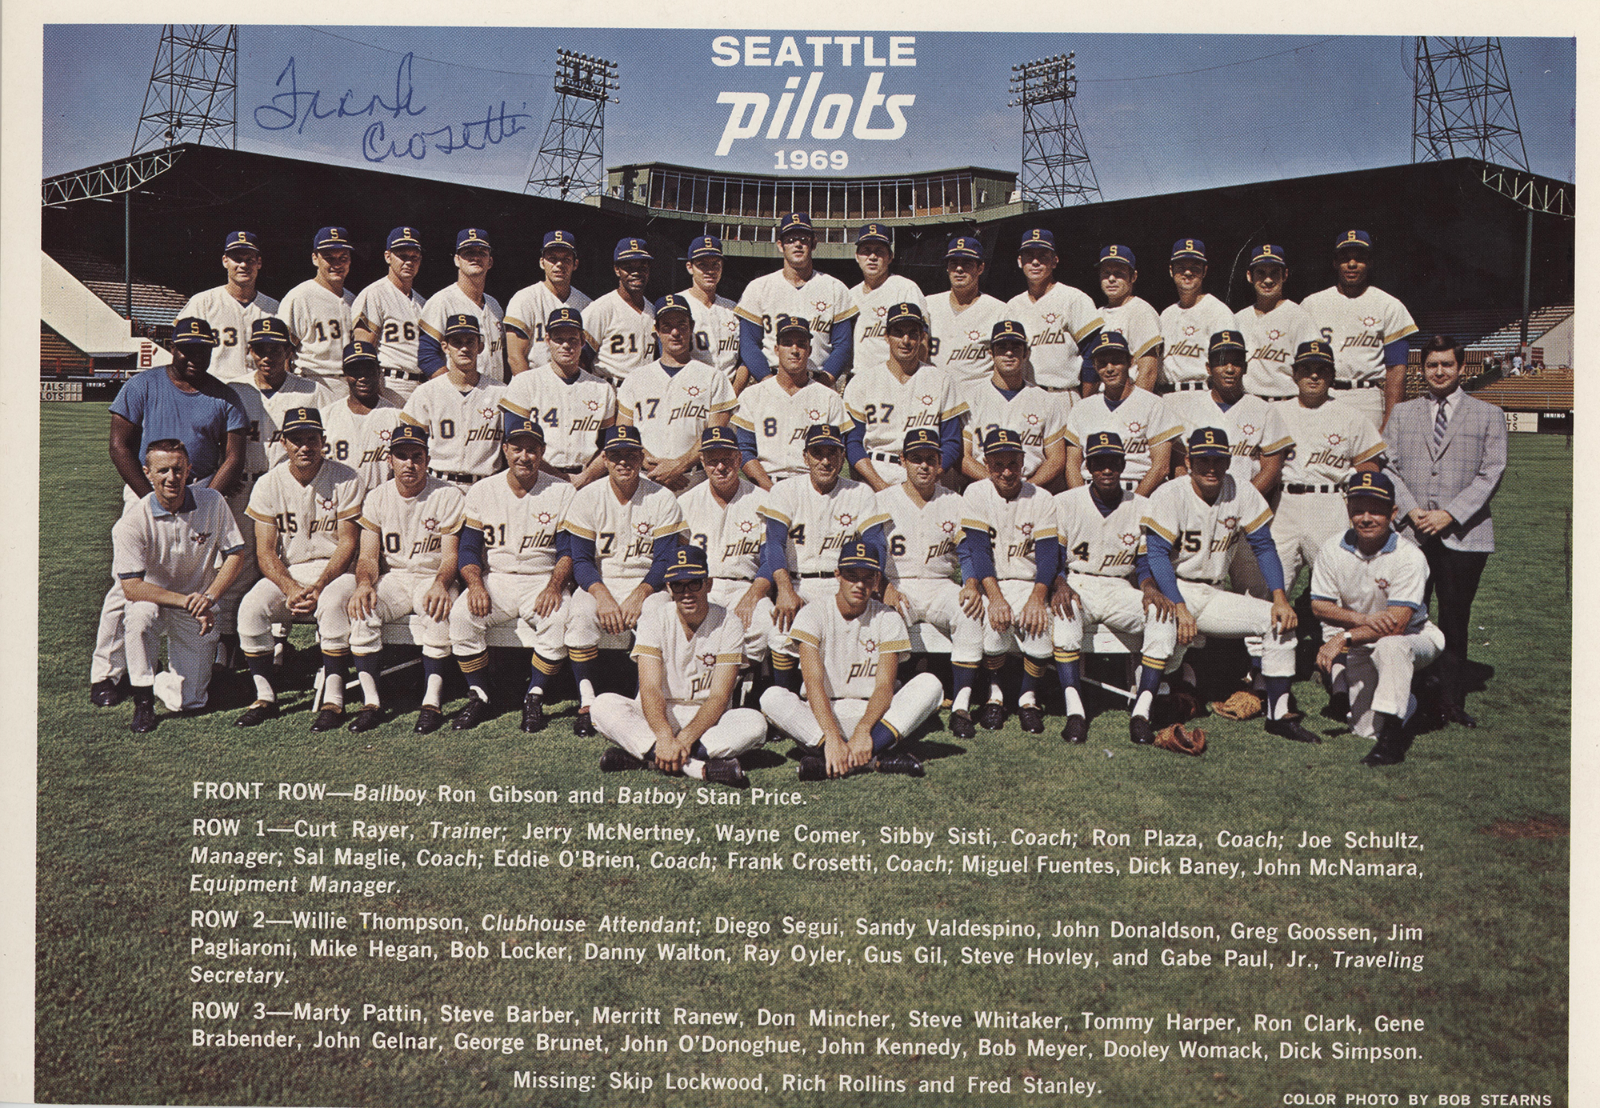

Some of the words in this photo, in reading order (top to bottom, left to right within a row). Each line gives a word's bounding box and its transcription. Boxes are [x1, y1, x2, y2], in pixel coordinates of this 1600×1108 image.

[253, 51, 427, 135] Frank
[238, 231, 247, 242] S
[330, 229, 339, 239] S
[1347, 230, 1357, 241] S
[314, 318, 343, 343] 13
[383, 320, 417, 343] 26
[610, 332, 638, 354] 21
[298, 408, 307, 420] S
[529, 406, 559, 428] 34
[634, 398, 661, 422] 17
[864, 403, 895, 425] 27
[763, 417, 777, 437] 8
[1205, 431, 1215, 444] S
[1362, 473, 1373, 487] S
[276, 512, 298, 534] 15
[483, 523, 506, 546] 31
[677, 550, 688, 565] S
[856, 544, 866, 557] S
